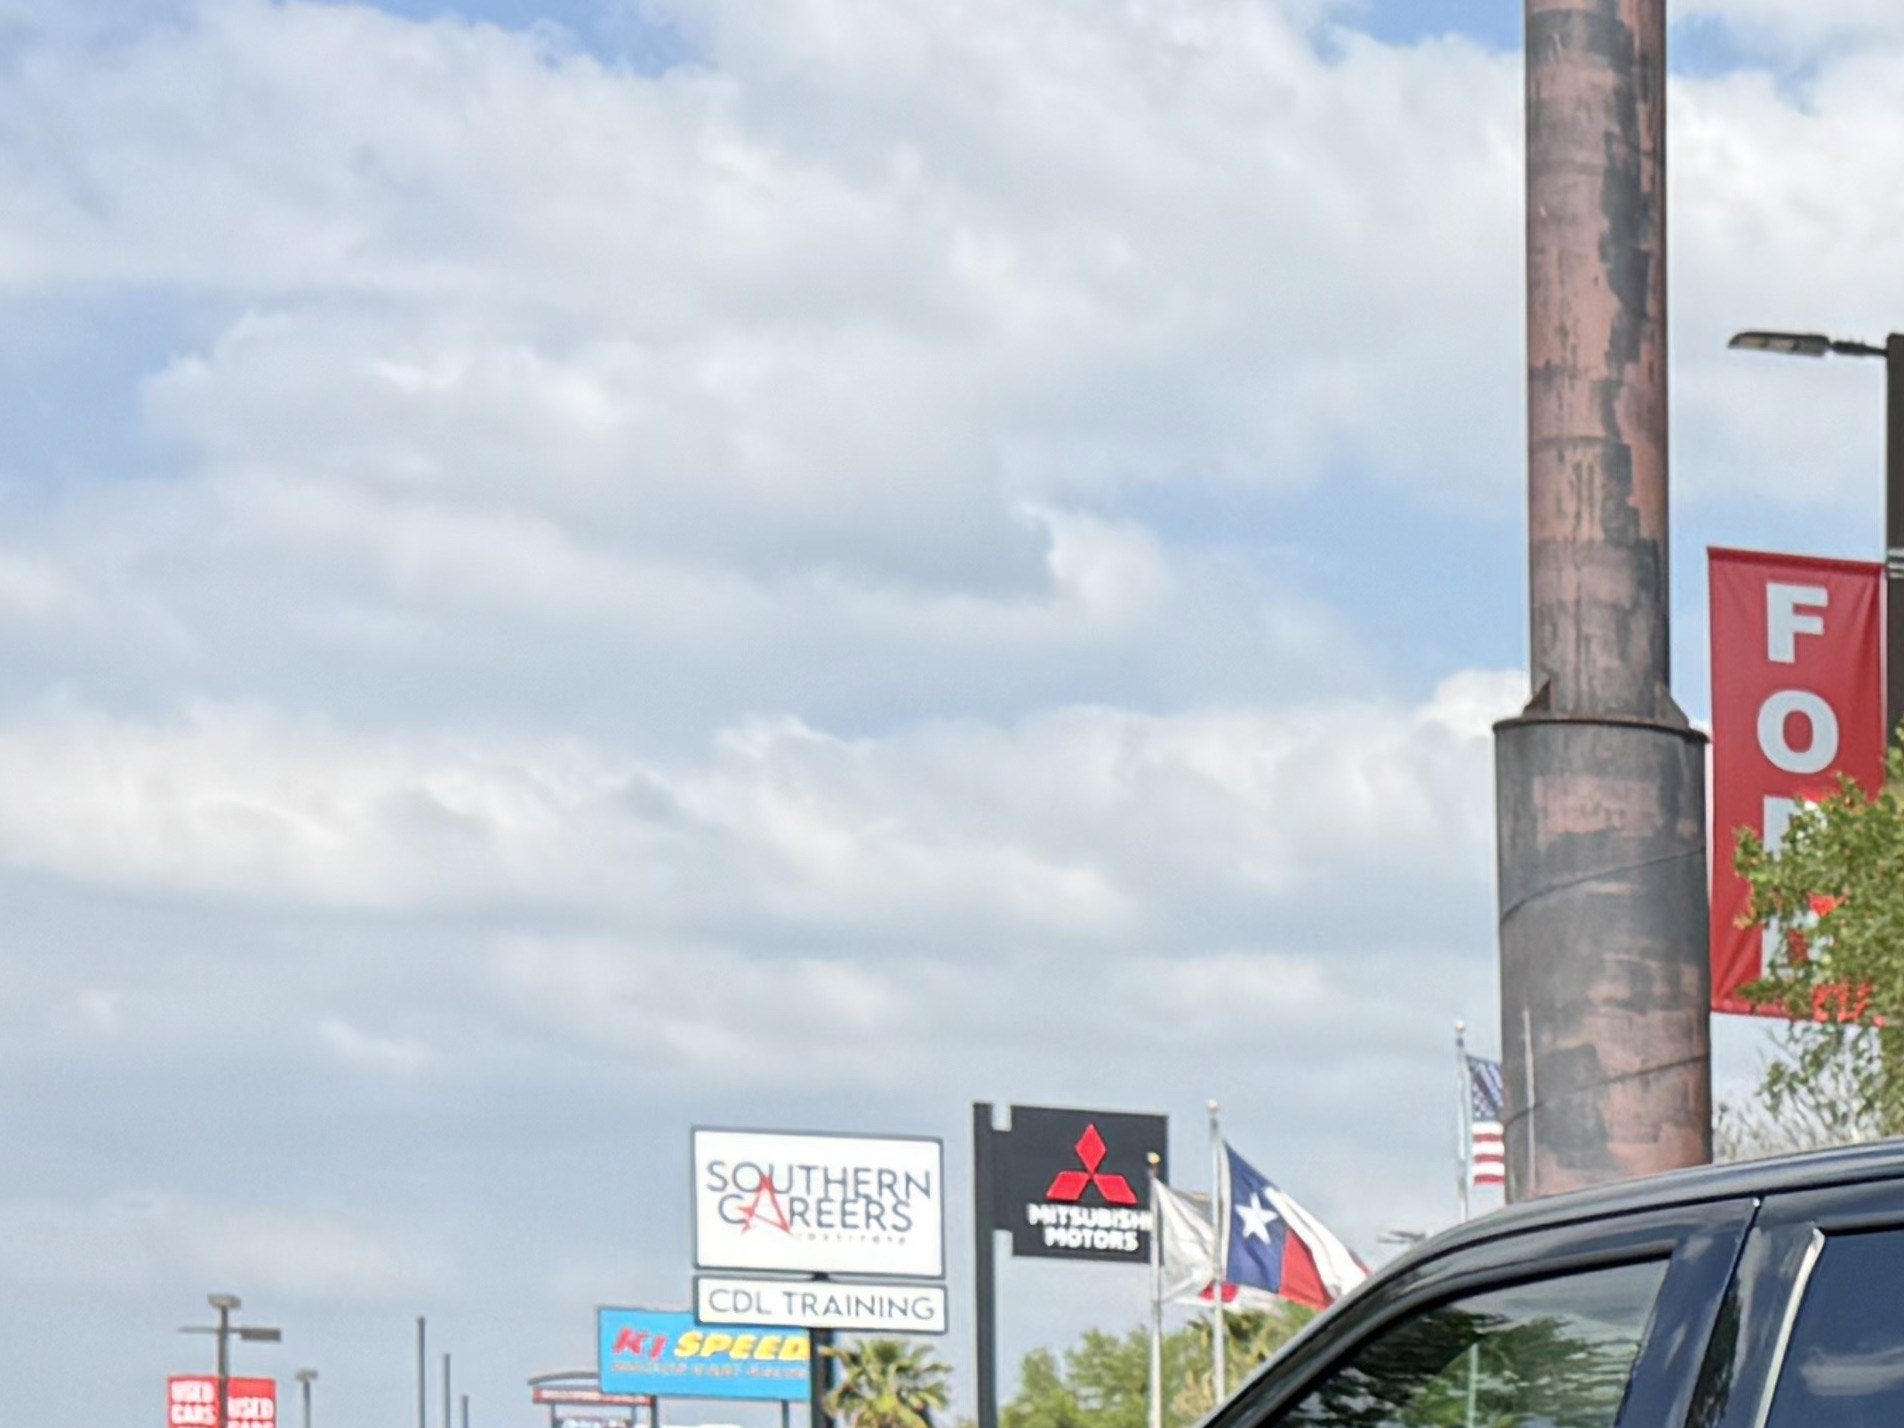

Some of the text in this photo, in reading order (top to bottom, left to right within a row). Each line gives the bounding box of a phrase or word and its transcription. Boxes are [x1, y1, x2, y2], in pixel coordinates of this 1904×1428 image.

[706, 1160, 931, 1201] SOUTHERN
[718, 1175, 913, 1235] CAREERS
[1044, 1227, 1139, 1252] MOTORS
[708, 1288, 935, 1321] CDL TRAINING
[674, 1329, 811, 1361] SPEED
